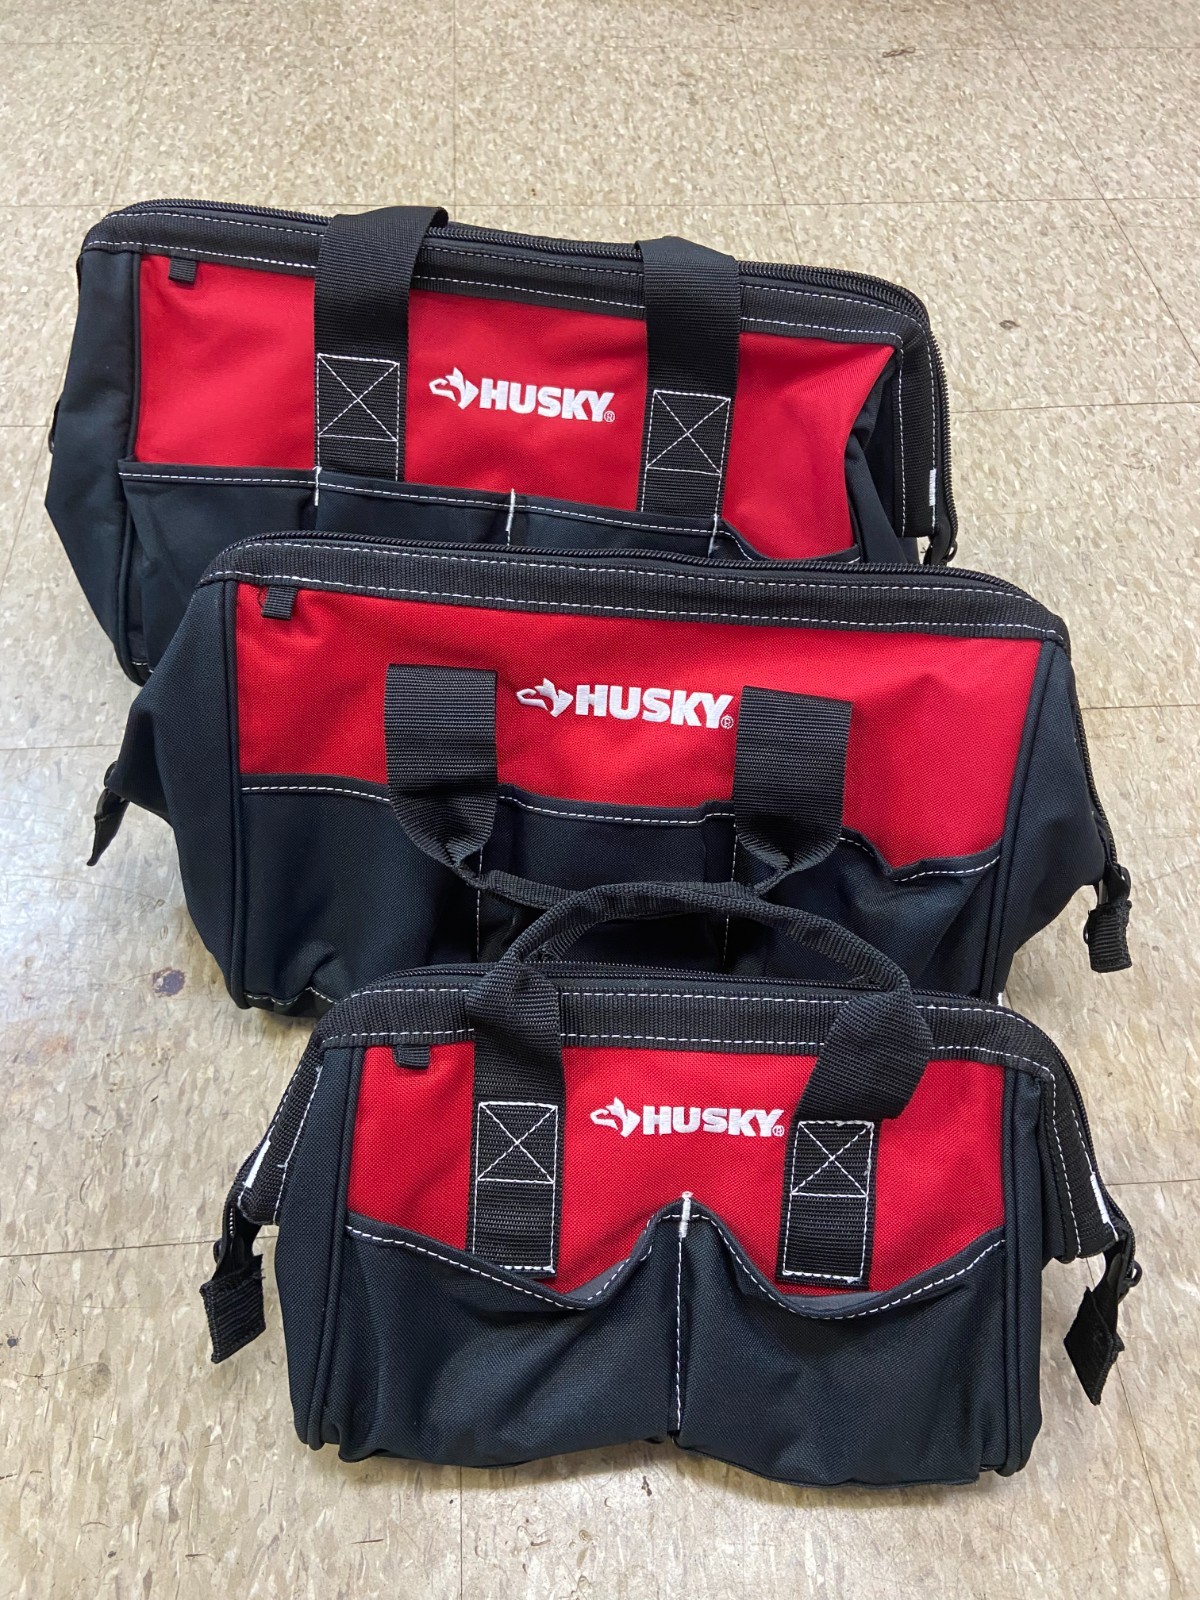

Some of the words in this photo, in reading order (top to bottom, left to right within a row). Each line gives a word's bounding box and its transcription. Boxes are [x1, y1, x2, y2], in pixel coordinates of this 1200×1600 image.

[480, 377, 615, 423] HUSKY
[575, 684, 734, 729] HUSKY
[643, 1105, 784, 1137] HUSKY
